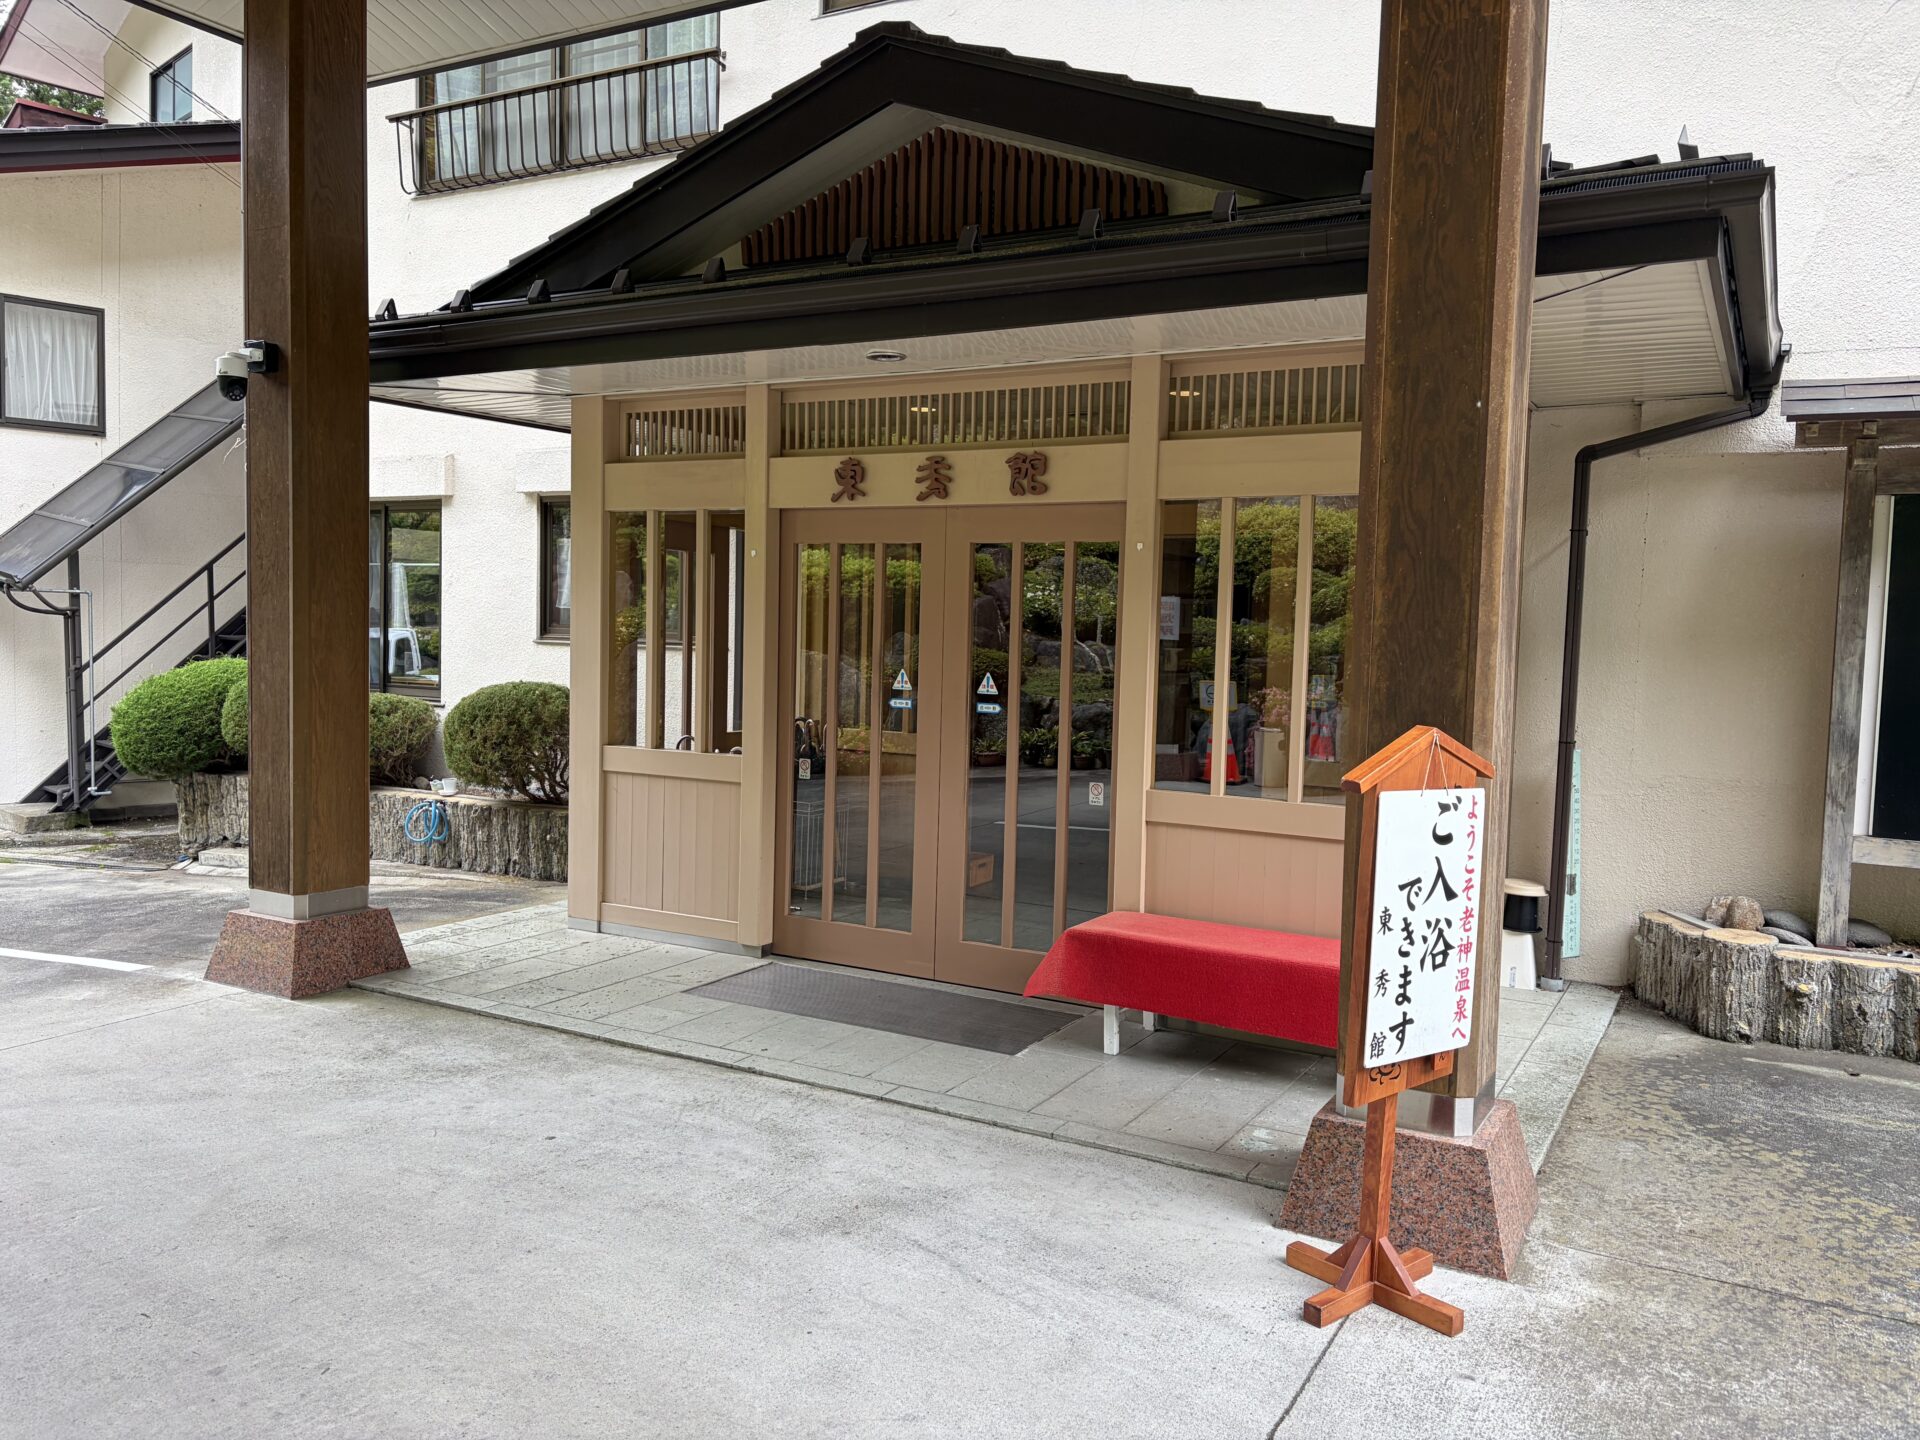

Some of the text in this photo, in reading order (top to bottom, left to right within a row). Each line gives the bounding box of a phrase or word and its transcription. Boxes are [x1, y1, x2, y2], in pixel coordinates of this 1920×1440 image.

[831, 451, 1047, 502] 東秀館
[1388, 876, 1423, 1056] できます
[1420, 795, 1463, 973] ご入浴
[1451, 794, 1478, 1039] ようこそ老神温泉へ
[1369, 905, 1394, 1060] 東秀館
